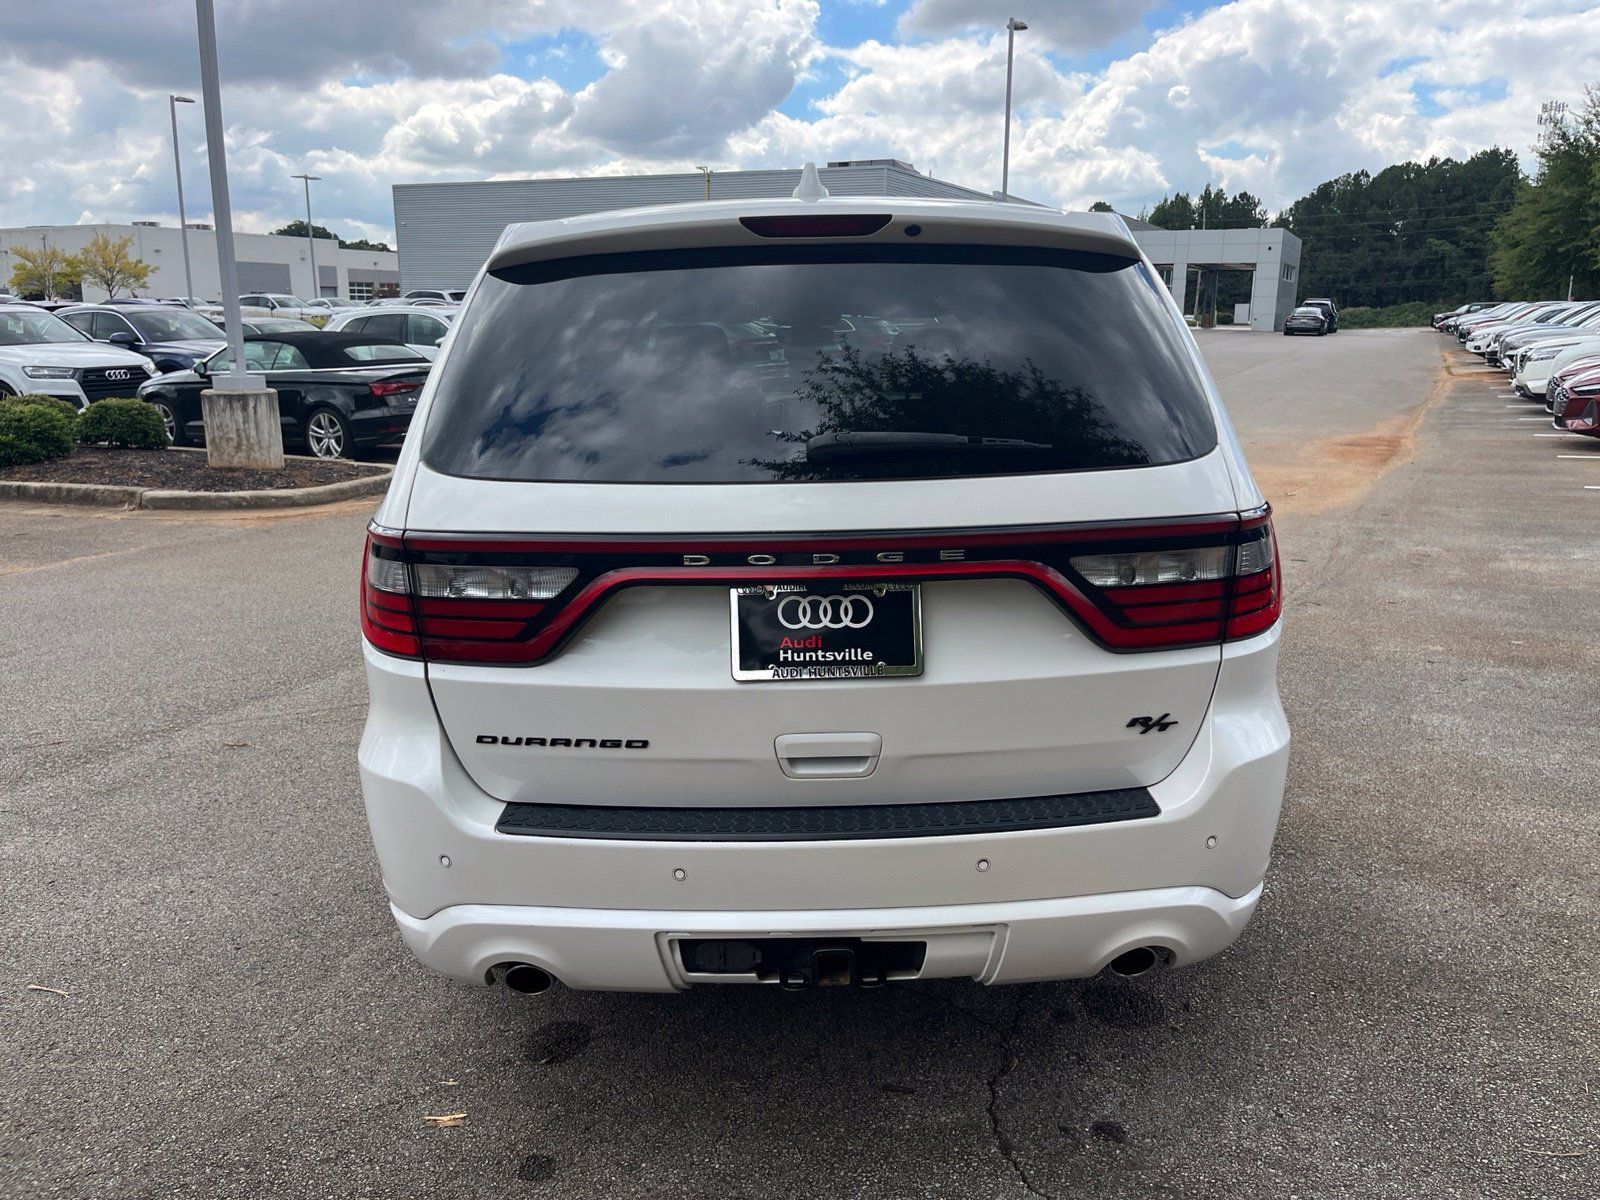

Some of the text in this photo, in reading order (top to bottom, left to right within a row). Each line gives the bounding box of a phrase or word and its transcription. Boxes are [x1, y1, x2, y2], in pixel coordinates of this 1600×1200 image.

[683, 549, 965, 565] DODGE
[780, 636, 823, 648] Audi
[779, 648, 873, 661] Huntsville
[772, 665, 885, 678] AUDI HUNTSVILLE
[1126, 713, 1178, 734] R/T
[476, 735, 649, 748] DURANGO
